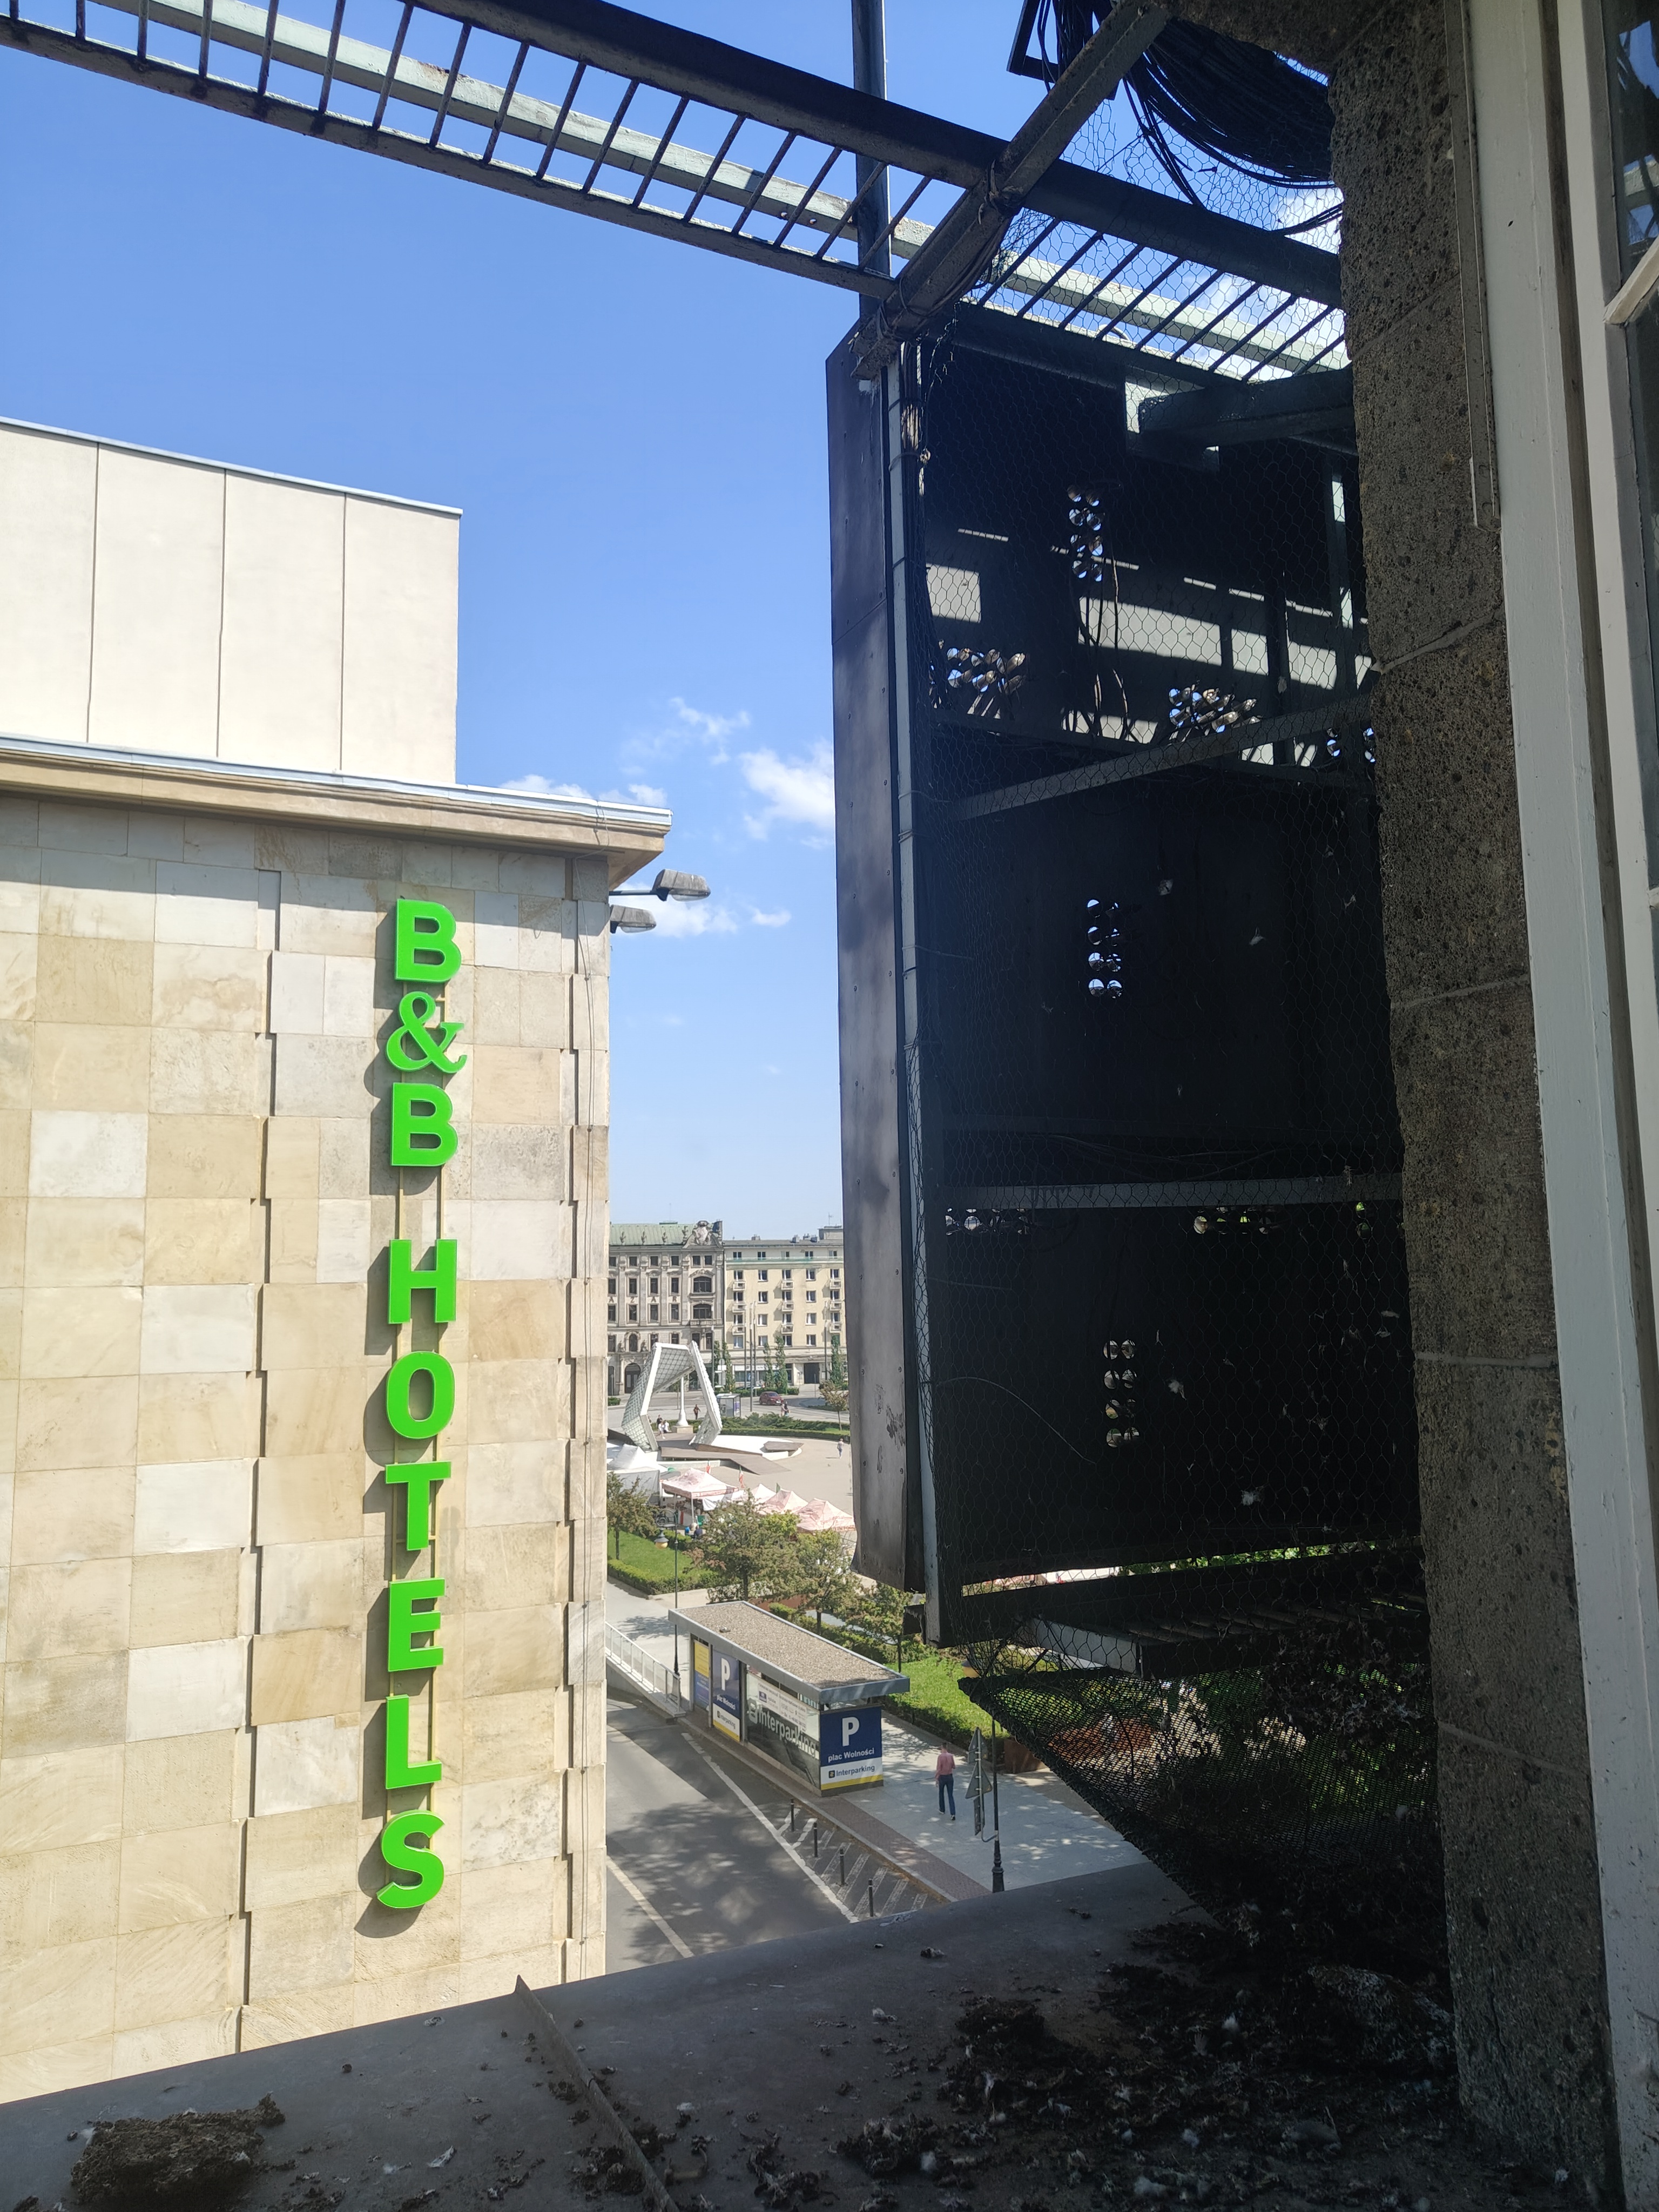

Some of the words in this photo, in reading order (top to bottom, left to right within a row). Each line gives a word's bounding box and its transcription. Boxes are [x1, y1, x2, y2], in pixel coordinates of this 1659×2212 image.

[386, 898, 468, 1167] B&B
[376, 1239, 457, 1908] HOTELS
[721, 1658, 730, 1691] P
[842, 1717, 860, 1746] P
[828, 1754, 842, 1763] plac
[844, 1748, 875, 1759] Wolności
[836, 1765, 875, 1776] Interparking
